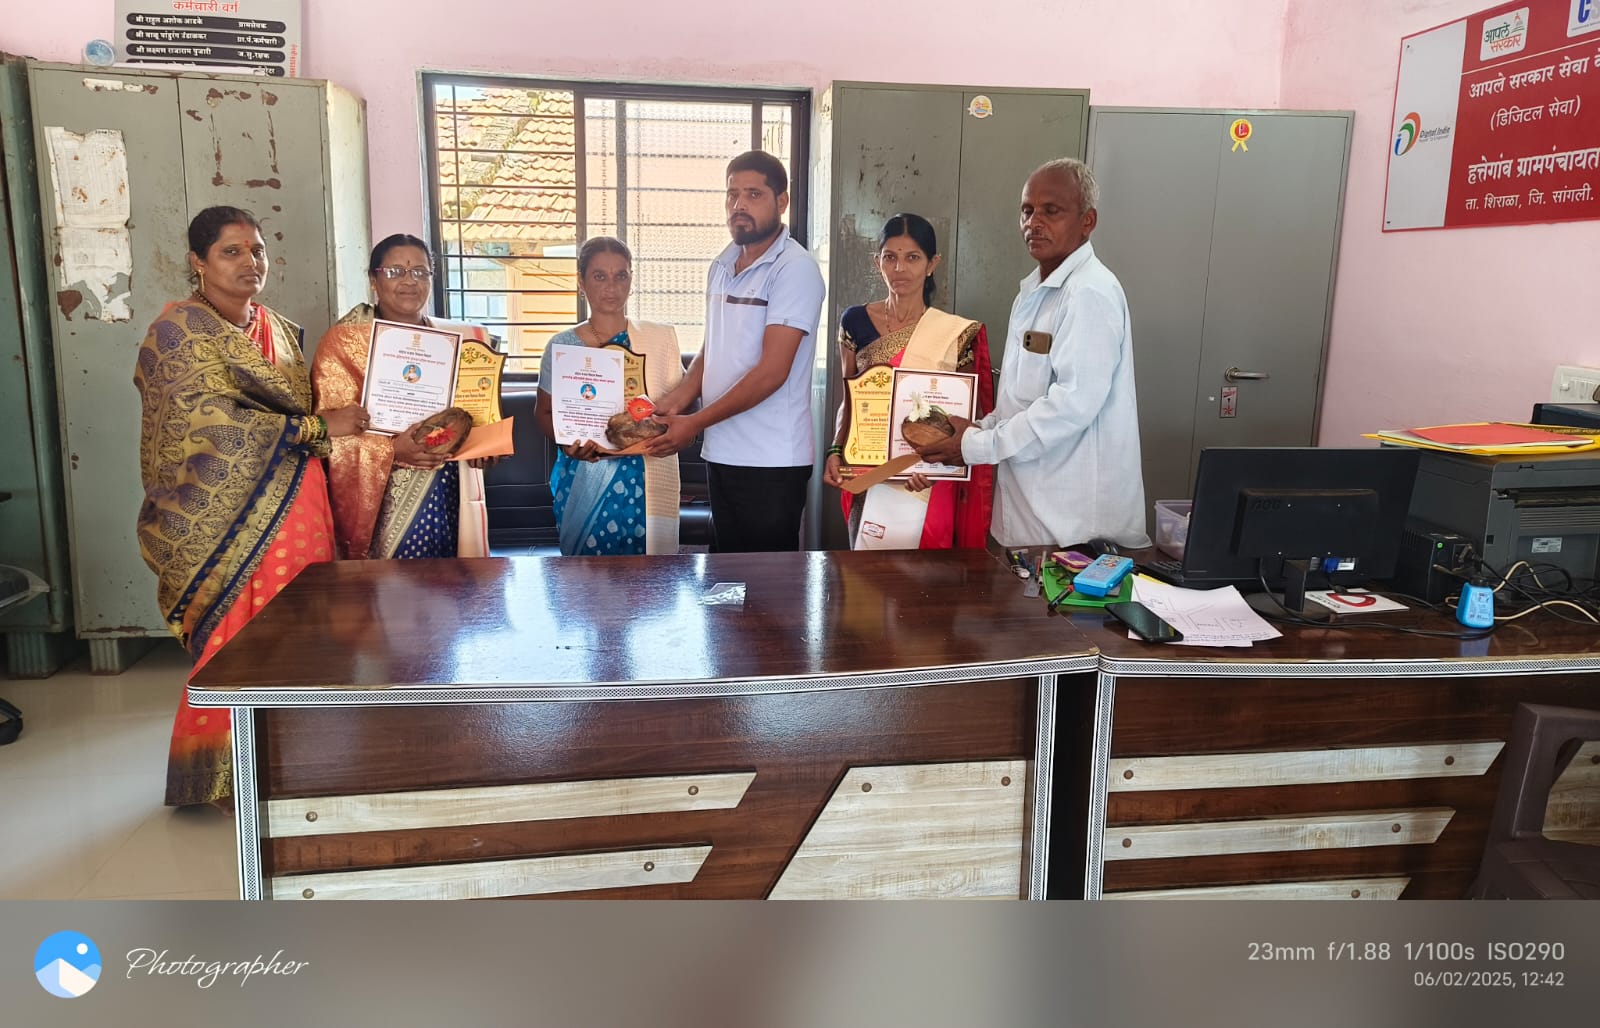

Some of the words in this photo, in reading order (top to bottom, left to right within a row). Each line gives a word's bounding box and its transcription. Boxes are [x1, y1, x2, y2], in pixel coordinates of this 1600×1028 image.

[173, 0, 219, 13] कर्मचारी
[221, 0, 240, 13] वर्ग
[238, 21, 267, 29] ग्रामसेवक
[1484, 22, 1510, 43] आपले
[193, 47, 212, 56] पुजारी
[1490, 33, 1522, 53] सरकार
[1469, 73, 1505, 98] आपले
[1509, 65, 1555, 88] सरकार
[1558, 56, 1590, 78] सेवा
[1490, 106, 1544, 131] (डिजिटल
[1548, 95, 1581, 118] सेवा)
[1467, 153, 1514, 185] हत्तेगांव
[1517, 145, 1600, 178] ग्रामपंचायत
[1465, 198, 1480, 211] ता.
[1483, 193, 1522, 209] शिराळा,
[1528, 188, 1546, 207] जि.
[1552, 183, 1594, 203] सांगली.
